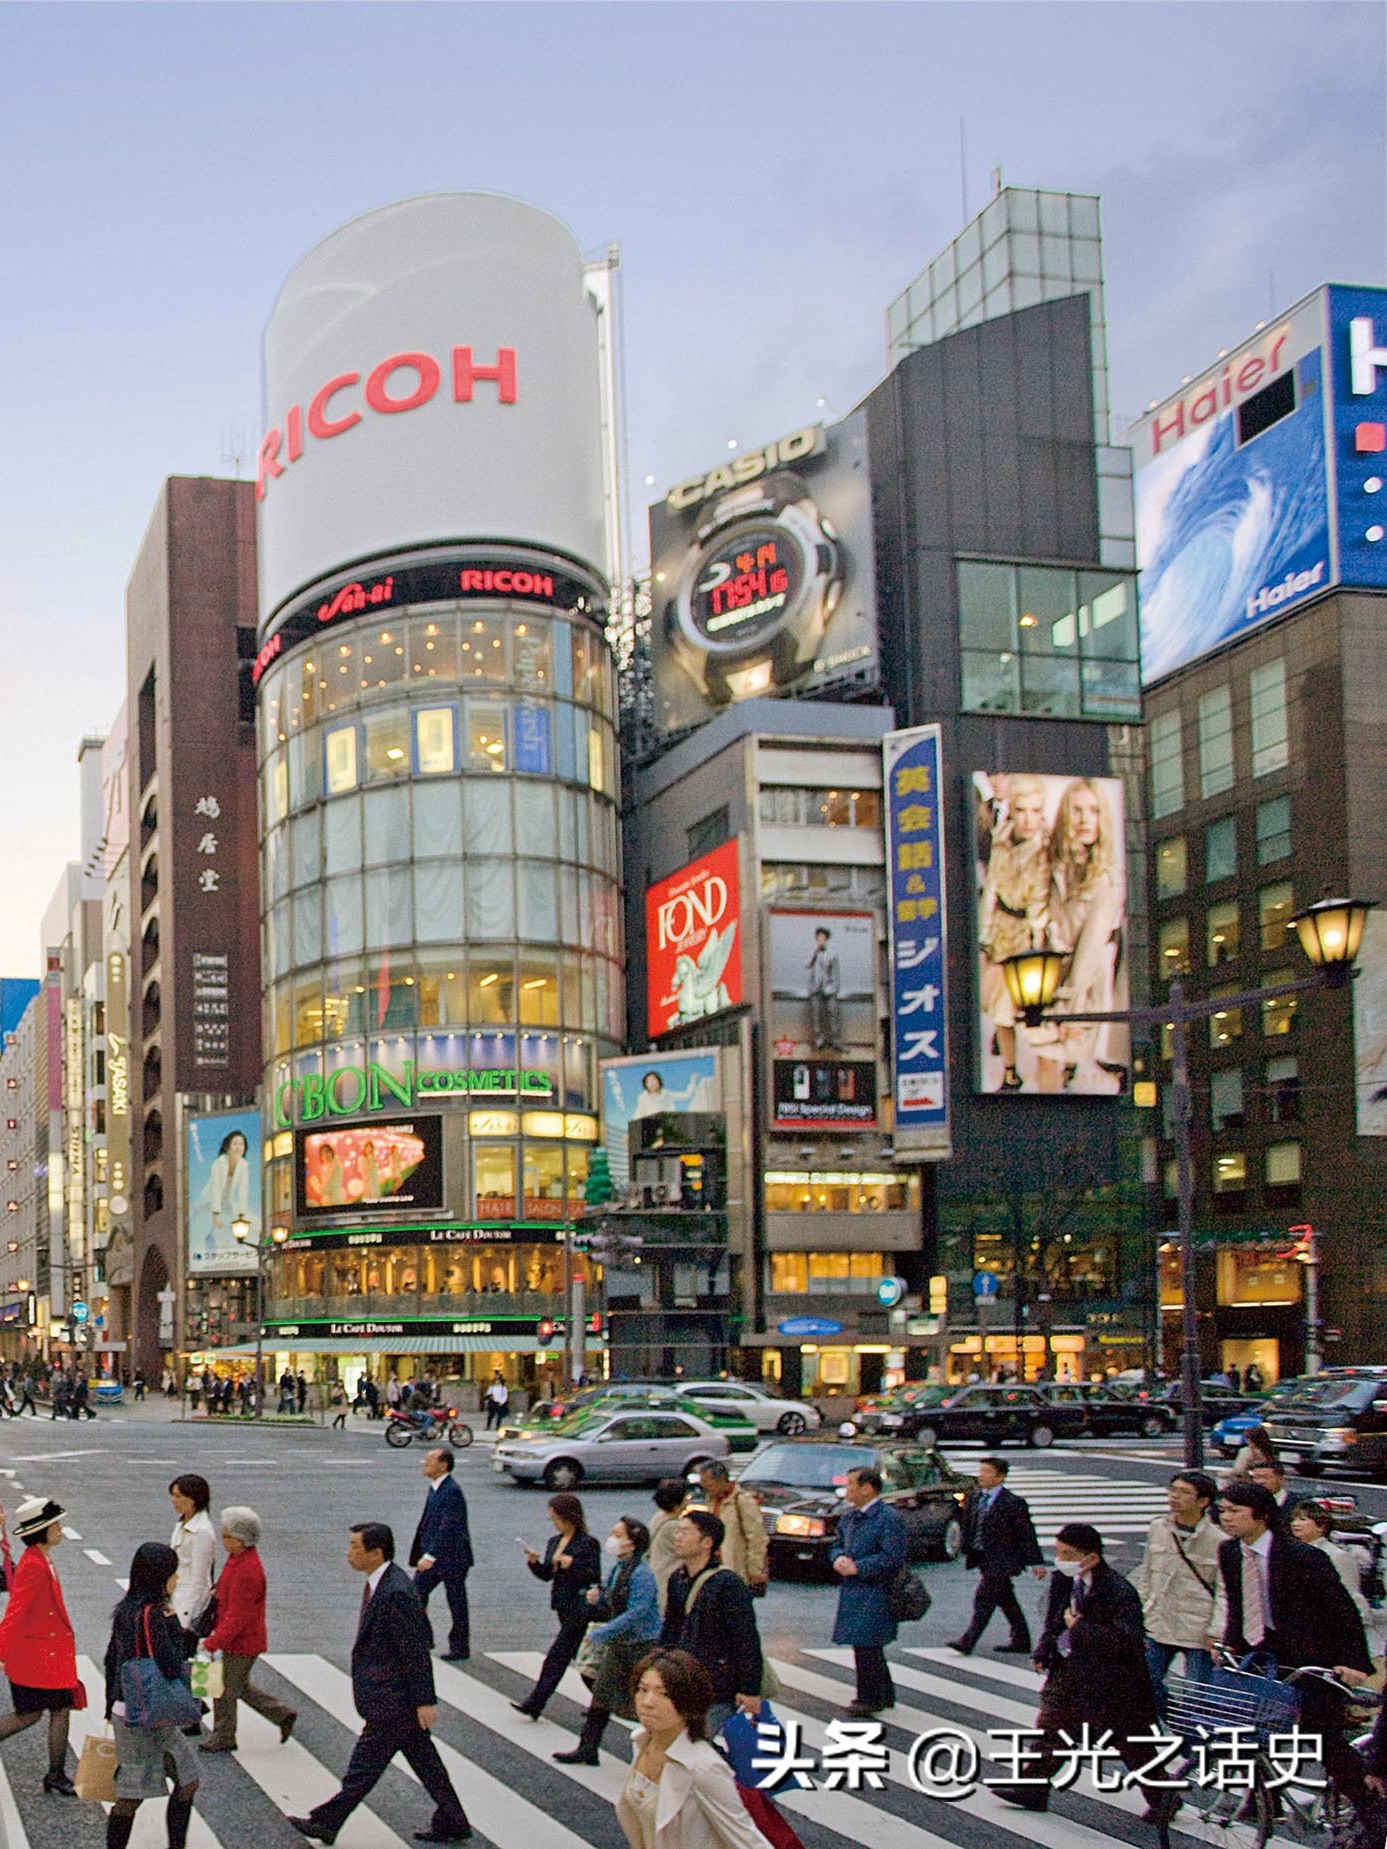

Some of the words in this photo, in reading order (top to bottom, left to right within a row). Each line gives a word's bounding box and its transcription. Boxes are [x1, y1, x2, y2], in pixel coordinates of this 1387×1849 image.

[254, 345, 518, 502] RICOH
[1152, 335, 1286, 454] Haier
[667, 427, 826, 511] CASIO
[460, 569, 554, 597] RICOH
[1246, 550, 1326, 619] Haier
[897, 937, 940, 1061] ジオス
[108, 1056, 127, 1115] TASAKI
[415, 1069, 552, 1092] COSMETICS
